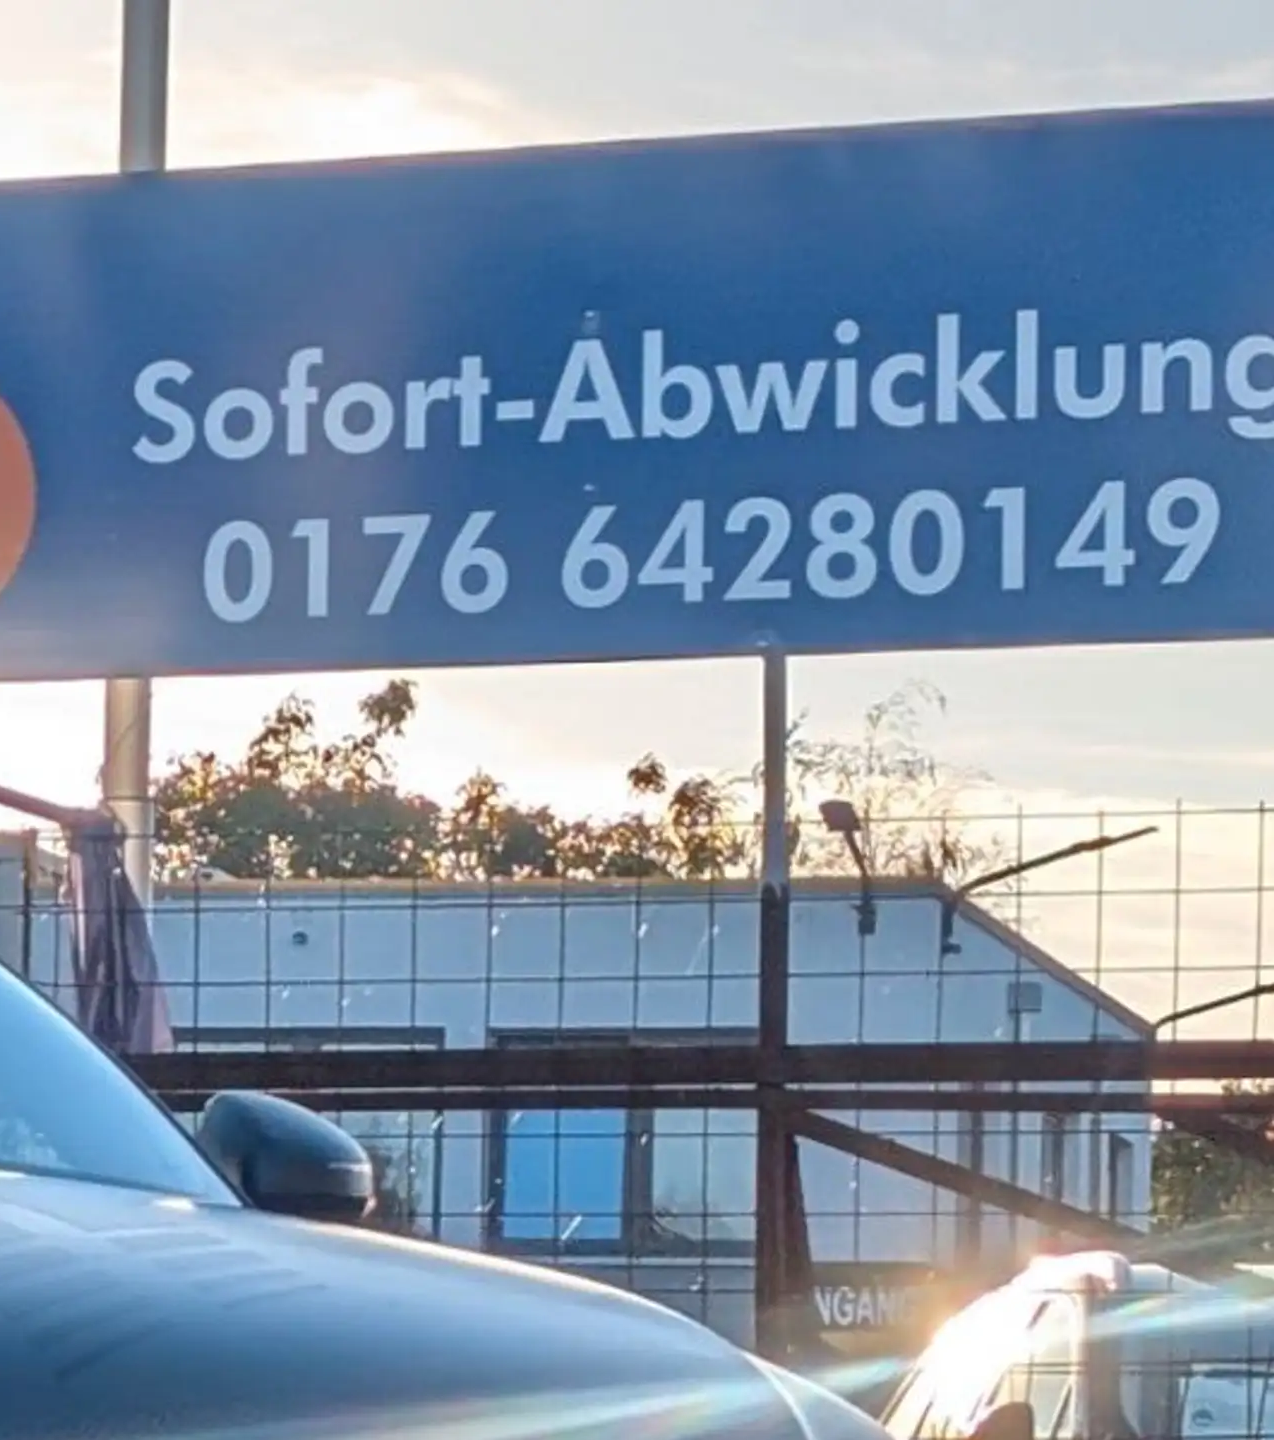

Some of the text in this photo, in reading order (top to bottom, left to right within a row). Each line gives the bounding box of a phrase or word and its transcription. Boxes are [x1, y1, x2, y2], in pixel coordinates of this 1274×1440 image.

[130, 309, 1274, 464] Sofort-Abwicklung
[203, 476, 1221, 624] 0176 64280149
